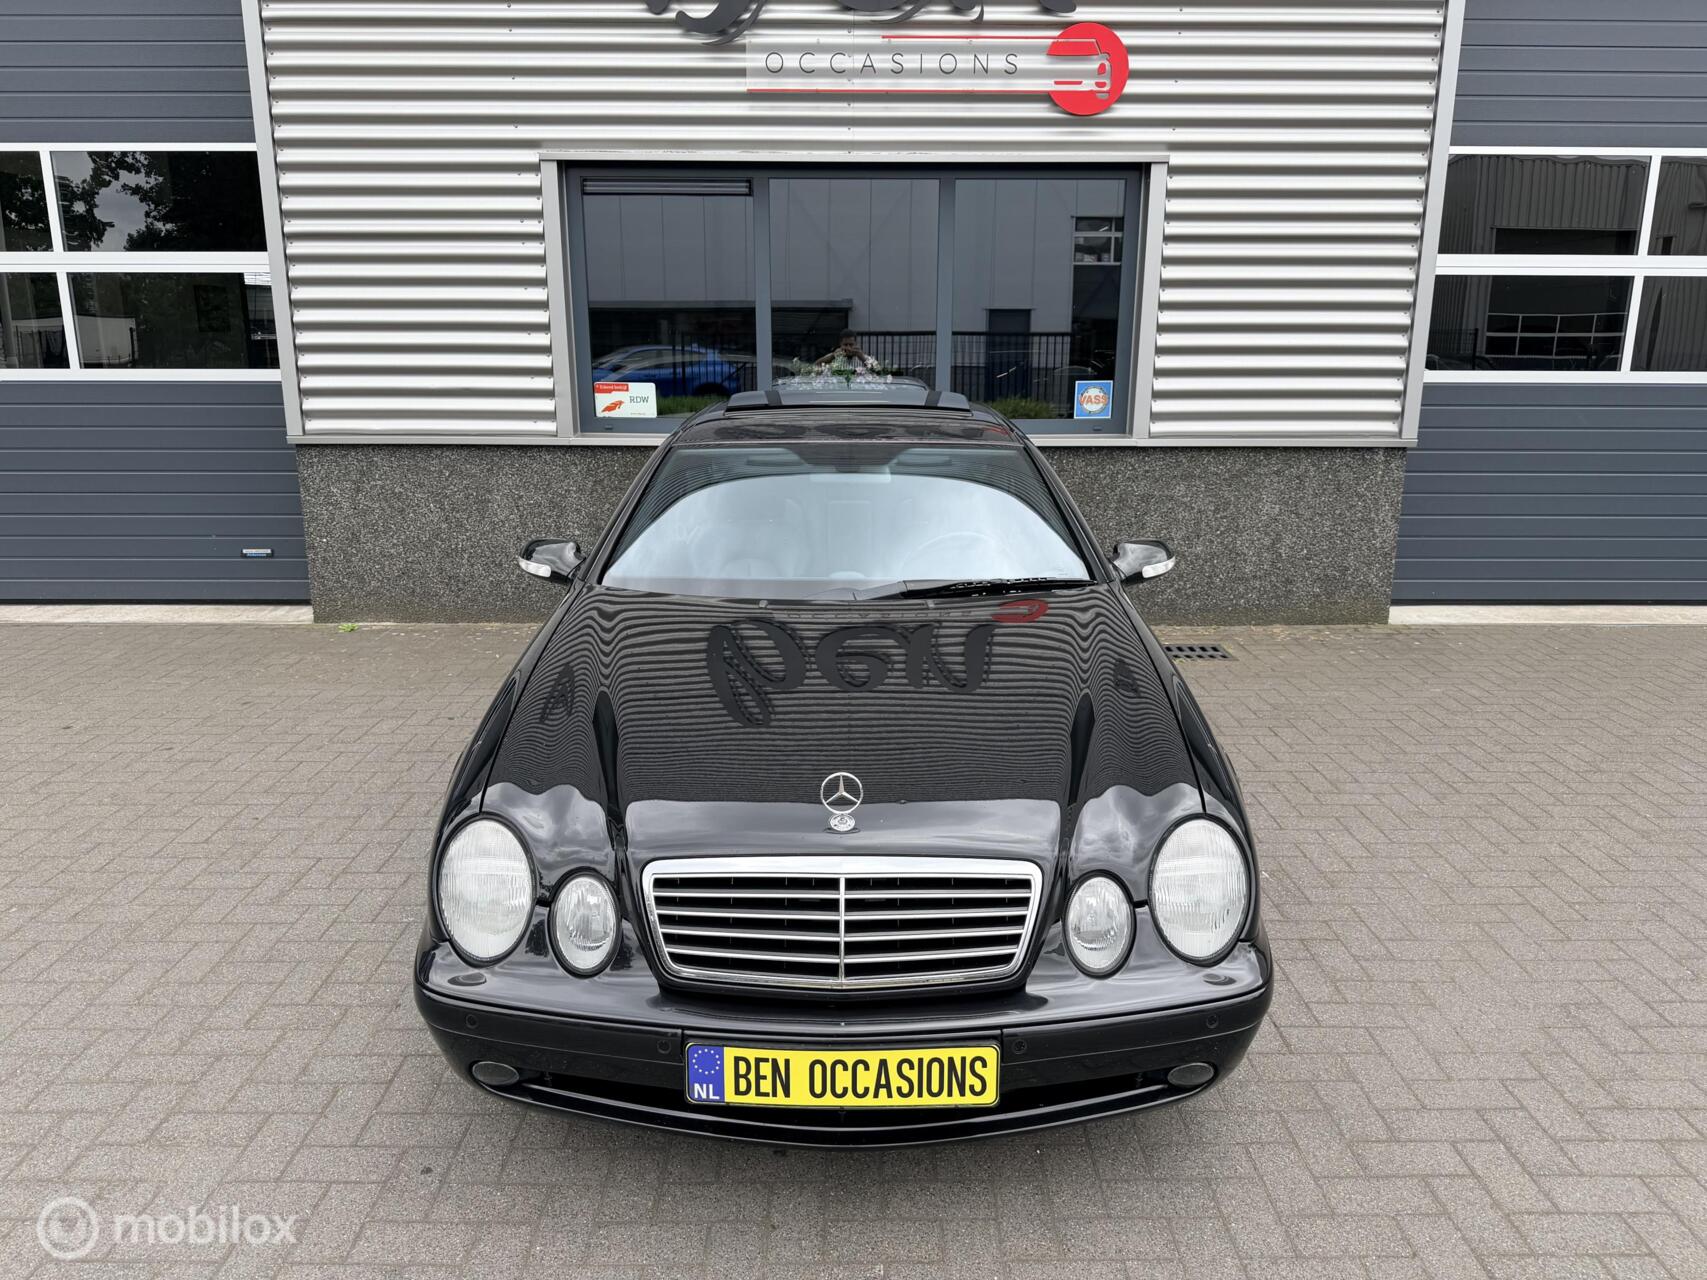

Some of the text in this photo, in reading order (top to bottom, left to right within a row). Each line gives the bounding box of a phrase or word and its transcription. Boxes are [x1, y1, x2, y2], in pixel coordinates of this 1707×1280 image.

[764, 51, 1019, 75] OCCASIONS
[629, 395, 649, 404] RDW
[733, 1055, 988, 1099] BEN OCCASIONS
[694, 1083, 720, 1100] NL
